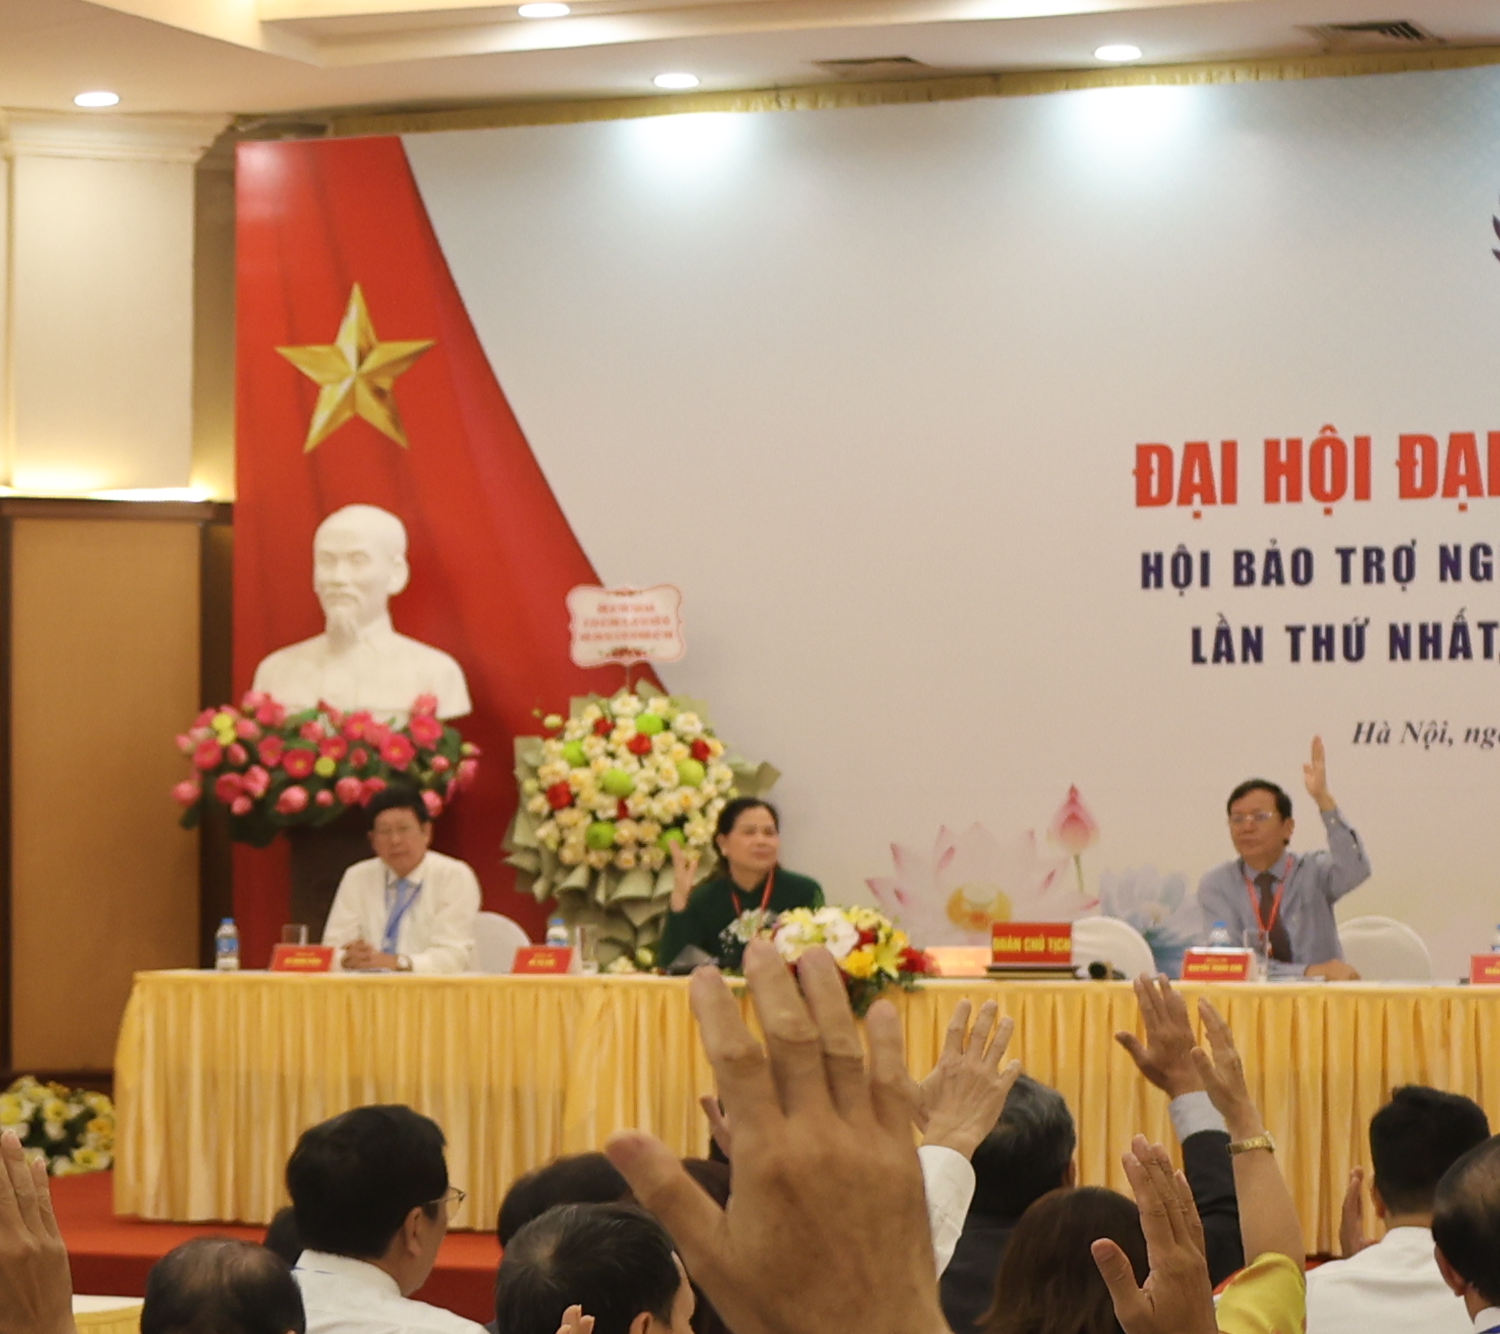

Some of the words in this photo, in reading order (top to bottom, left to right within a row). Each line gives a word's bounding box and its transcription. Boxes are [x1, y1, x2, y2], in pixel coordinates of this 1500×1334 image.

[1131, 438, 1239, 521] ĐẠI
[1262, 423, 1372, 518] HỘI
[1140, 543, 1211, 598] HỘI
[1232, 538, 1315, 589] BẢO
[1334, 538, 1418, 593] TRỢ
[1190, 612, 1264, 666] LẦN
[1283, 616, 1371, 664] THỨ
[1351, 720, 1391, 746] Hà
[1400, 720, 1454, 751] Nội,
